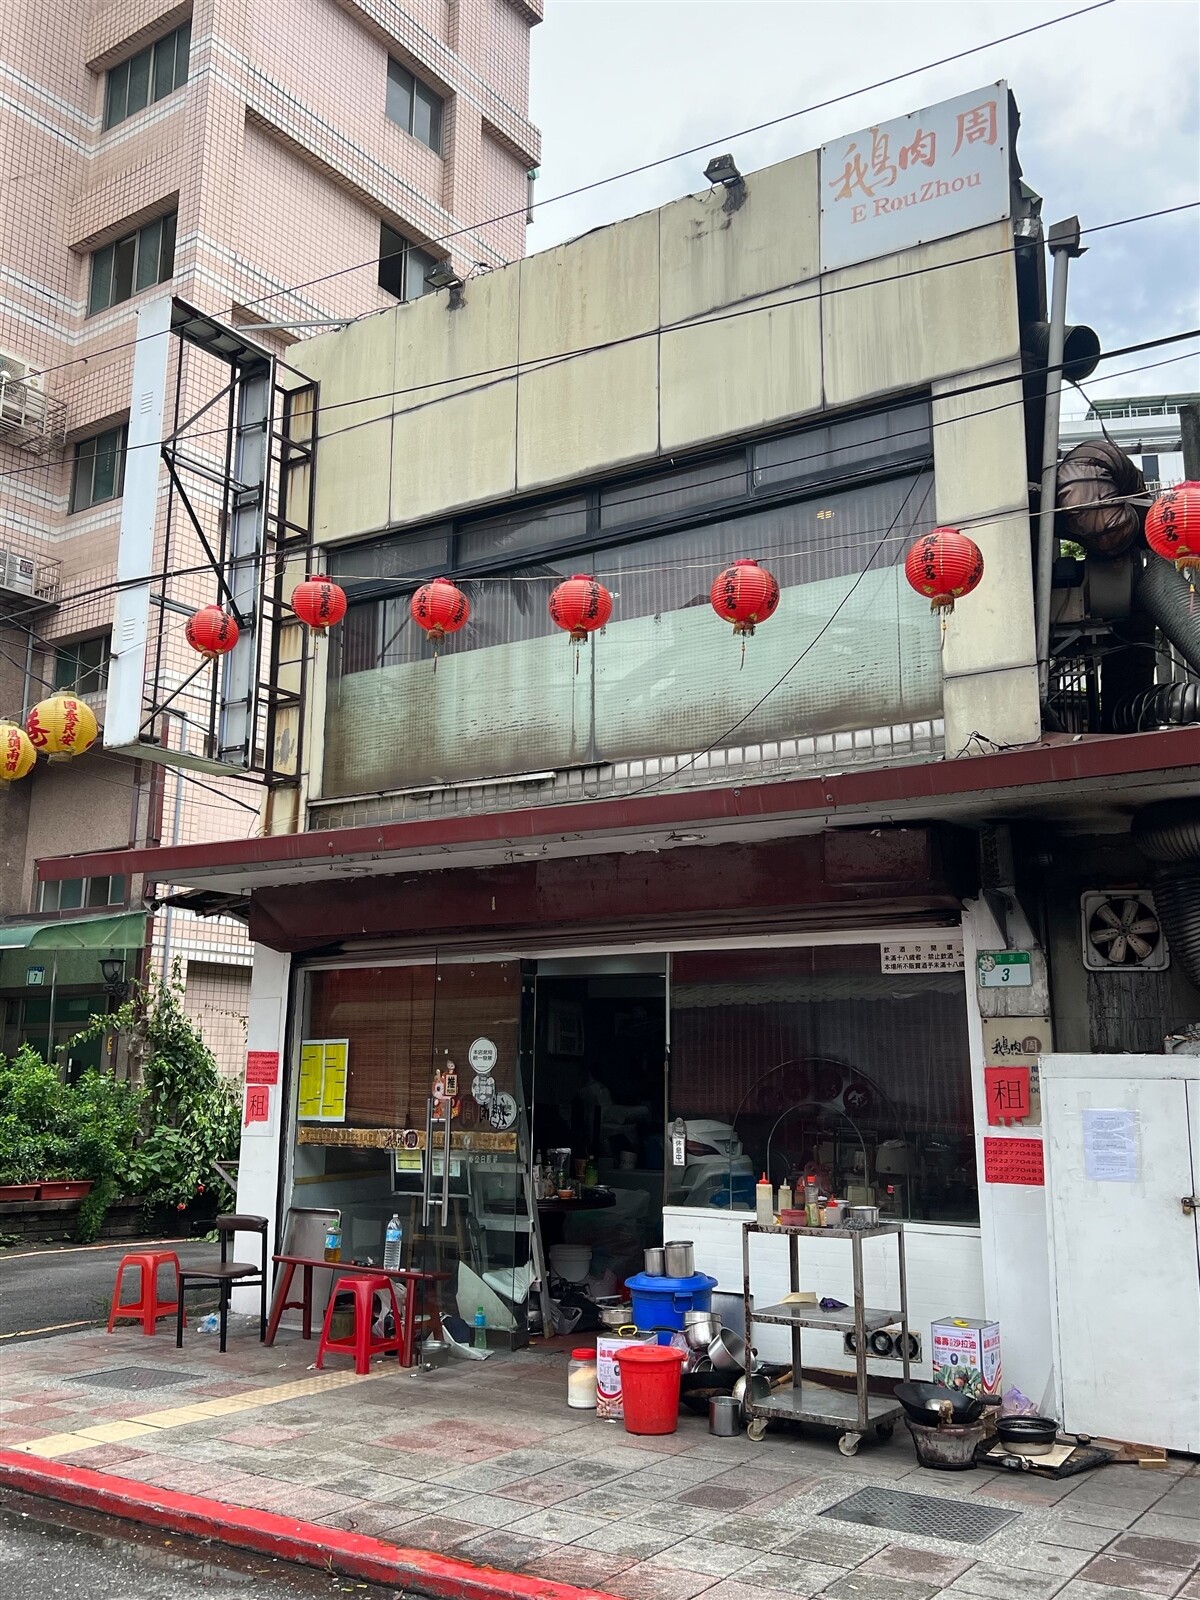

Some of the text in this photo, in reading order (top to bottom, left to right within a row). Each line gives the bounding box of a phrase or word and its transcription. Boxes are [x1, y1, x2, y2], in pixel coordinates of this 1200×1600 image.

[828, 101, 997, 201] 鵝肉周
[850, 171, 982, 224] E RouZhou
[59, 700, 79, 746] 國泰民安
[5, 729, 21, 772] 風調雨順
[33, 973, 38, 982] 7
[1001, 967, 1011, 982] 3
[249, 1094, 266, 1117] 租
[993, 1079, 1025, 1110] 租
[675, 1139, 683, 1160] 休息中
